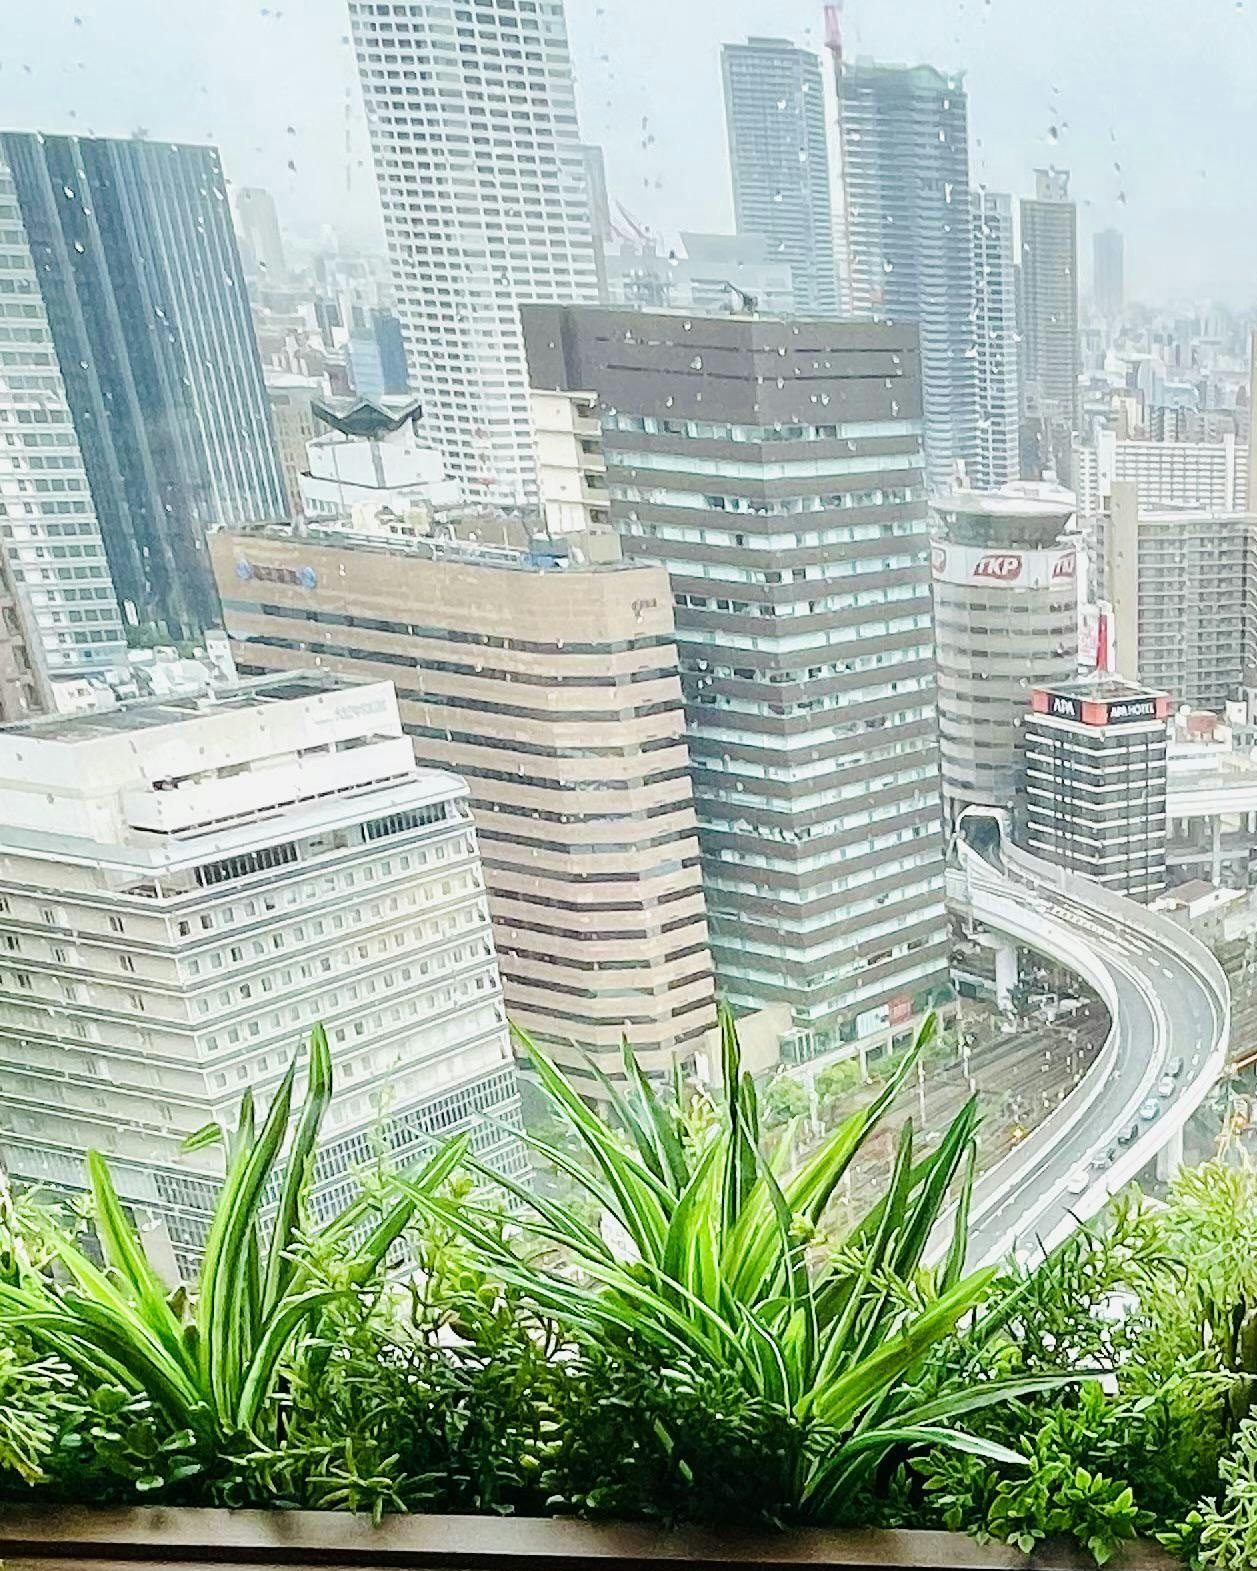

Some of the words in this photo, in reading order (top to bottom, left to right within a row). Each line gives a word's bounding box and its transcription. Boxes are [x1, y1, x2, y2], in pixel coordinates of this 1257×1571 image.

[976, 557, 1020, 577] TKP
[1053, 698, 1075, 716] APA
[1110, 705, 1128, 718] APA
[1128, 702, 1155, 715] HOTEL
